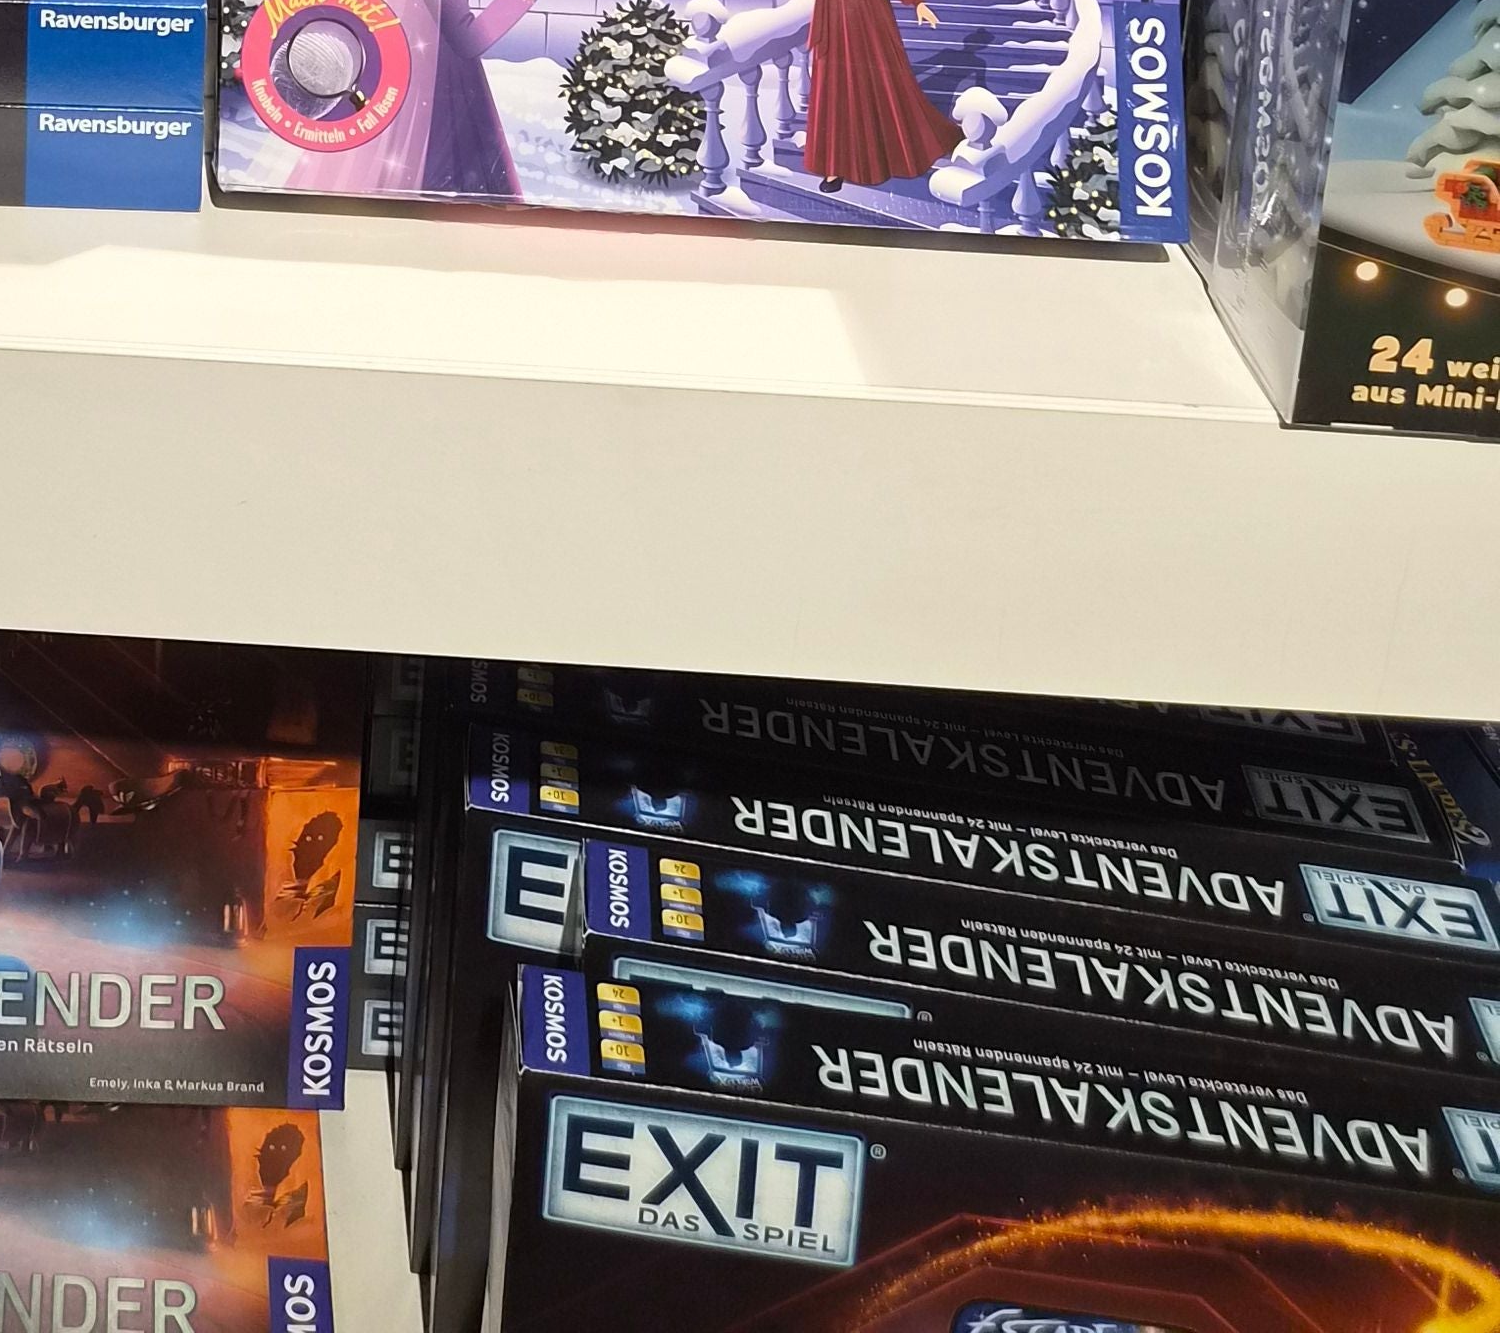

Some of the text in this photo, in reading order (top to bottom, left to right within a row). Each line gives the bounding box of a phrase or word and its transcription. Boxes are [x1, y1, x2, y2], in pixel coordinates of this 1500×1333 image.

[39, 9, 194, 36] Ravensburger
[39, 113, 192, 139] Ravensburger
[1135, 16, 1174, 219] KOSMOS
[1367, 335, 1434, 376] 24
[1350, 383, 1500, 412] aus Mini-
[607, 848, 630, 929] KOSMOS
[731, 795, 1285, 917] ADVENTSKALENDER
[1322, 882, 1490, 942] EXIT
[301, 961, 337, 1097] KOSMOS
[542, 974, 568, 1064] KOSMOS
[863, 920, 1456, 1057] ADVENTSKALENDER
[23, 1036, 94, 1055] Rätseln
[811, 1044, 1430, 1176] ADVENTSKALENDER
[562, 1113, 844, 1239] EXIT
[638, 1206, 836, 1254] DAS SPIEL
